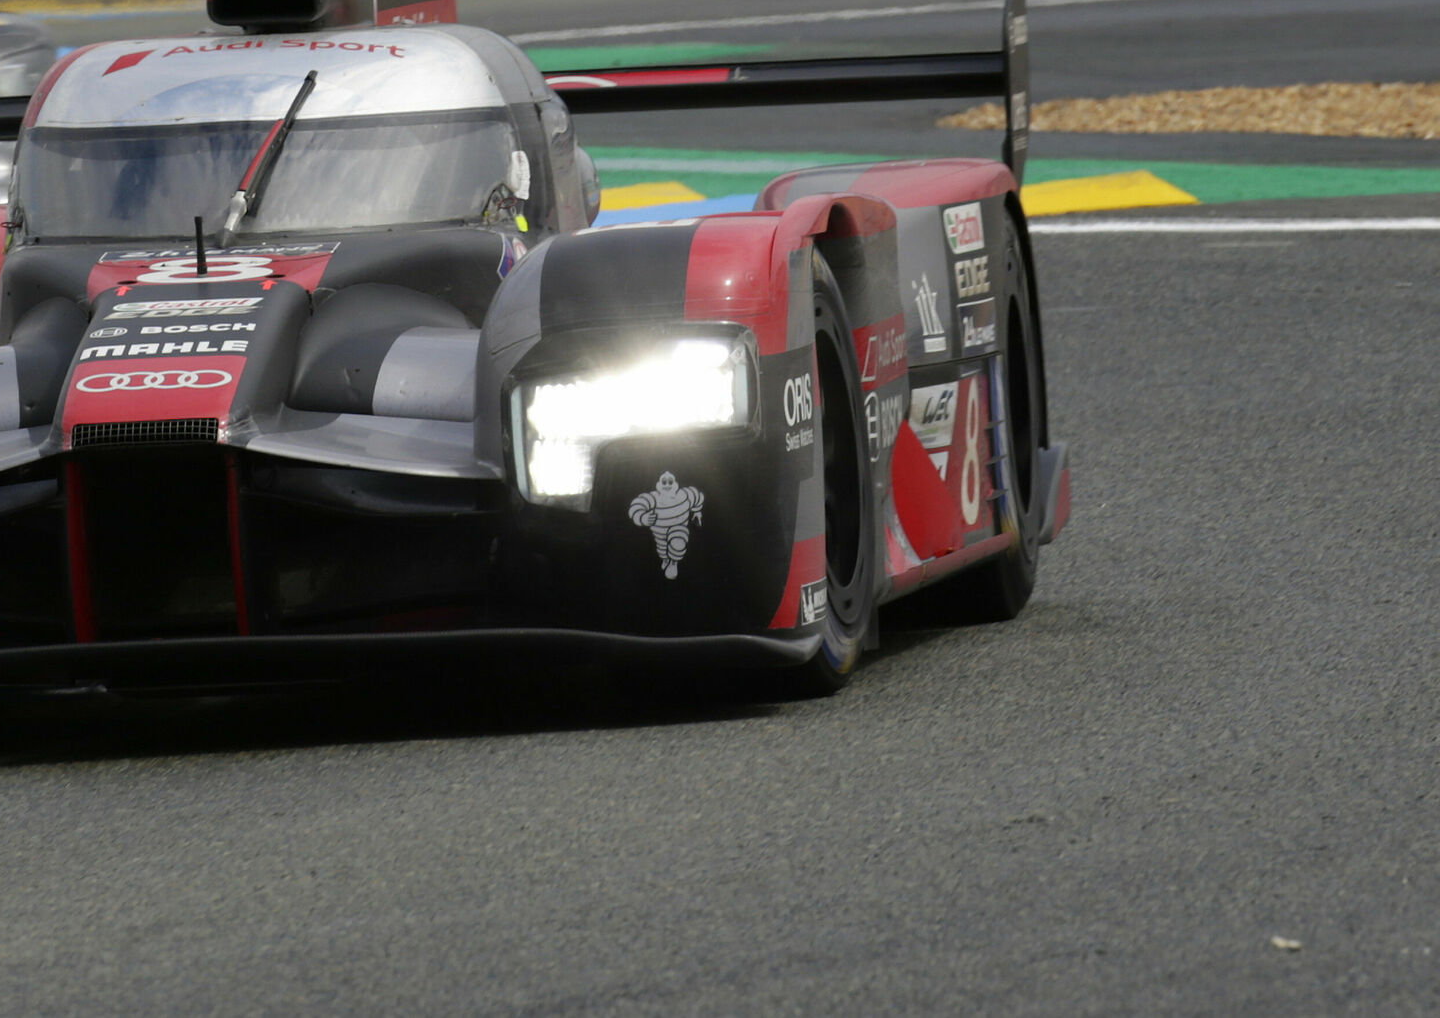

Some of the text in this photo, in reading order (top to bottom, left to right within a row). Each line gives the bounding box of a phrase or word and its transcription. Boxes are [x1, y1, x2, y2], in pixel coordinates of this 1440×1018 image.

[162, 38, 406, 59] Audi Sport
[135, 255, 275, 284] 8
[954, 255, 991, 298] EDGE
[103, 307, 261, 320] EDGE
[148, 298, 251, 310] Castrol
[140, 322, 257, 335] BOSCH
[79, 339, 250, 361] MAHLE
[783, 373, 813, 428] ORIS
[921, 389, 954, 425] WEC
[961, 378, 980, 525] 8
